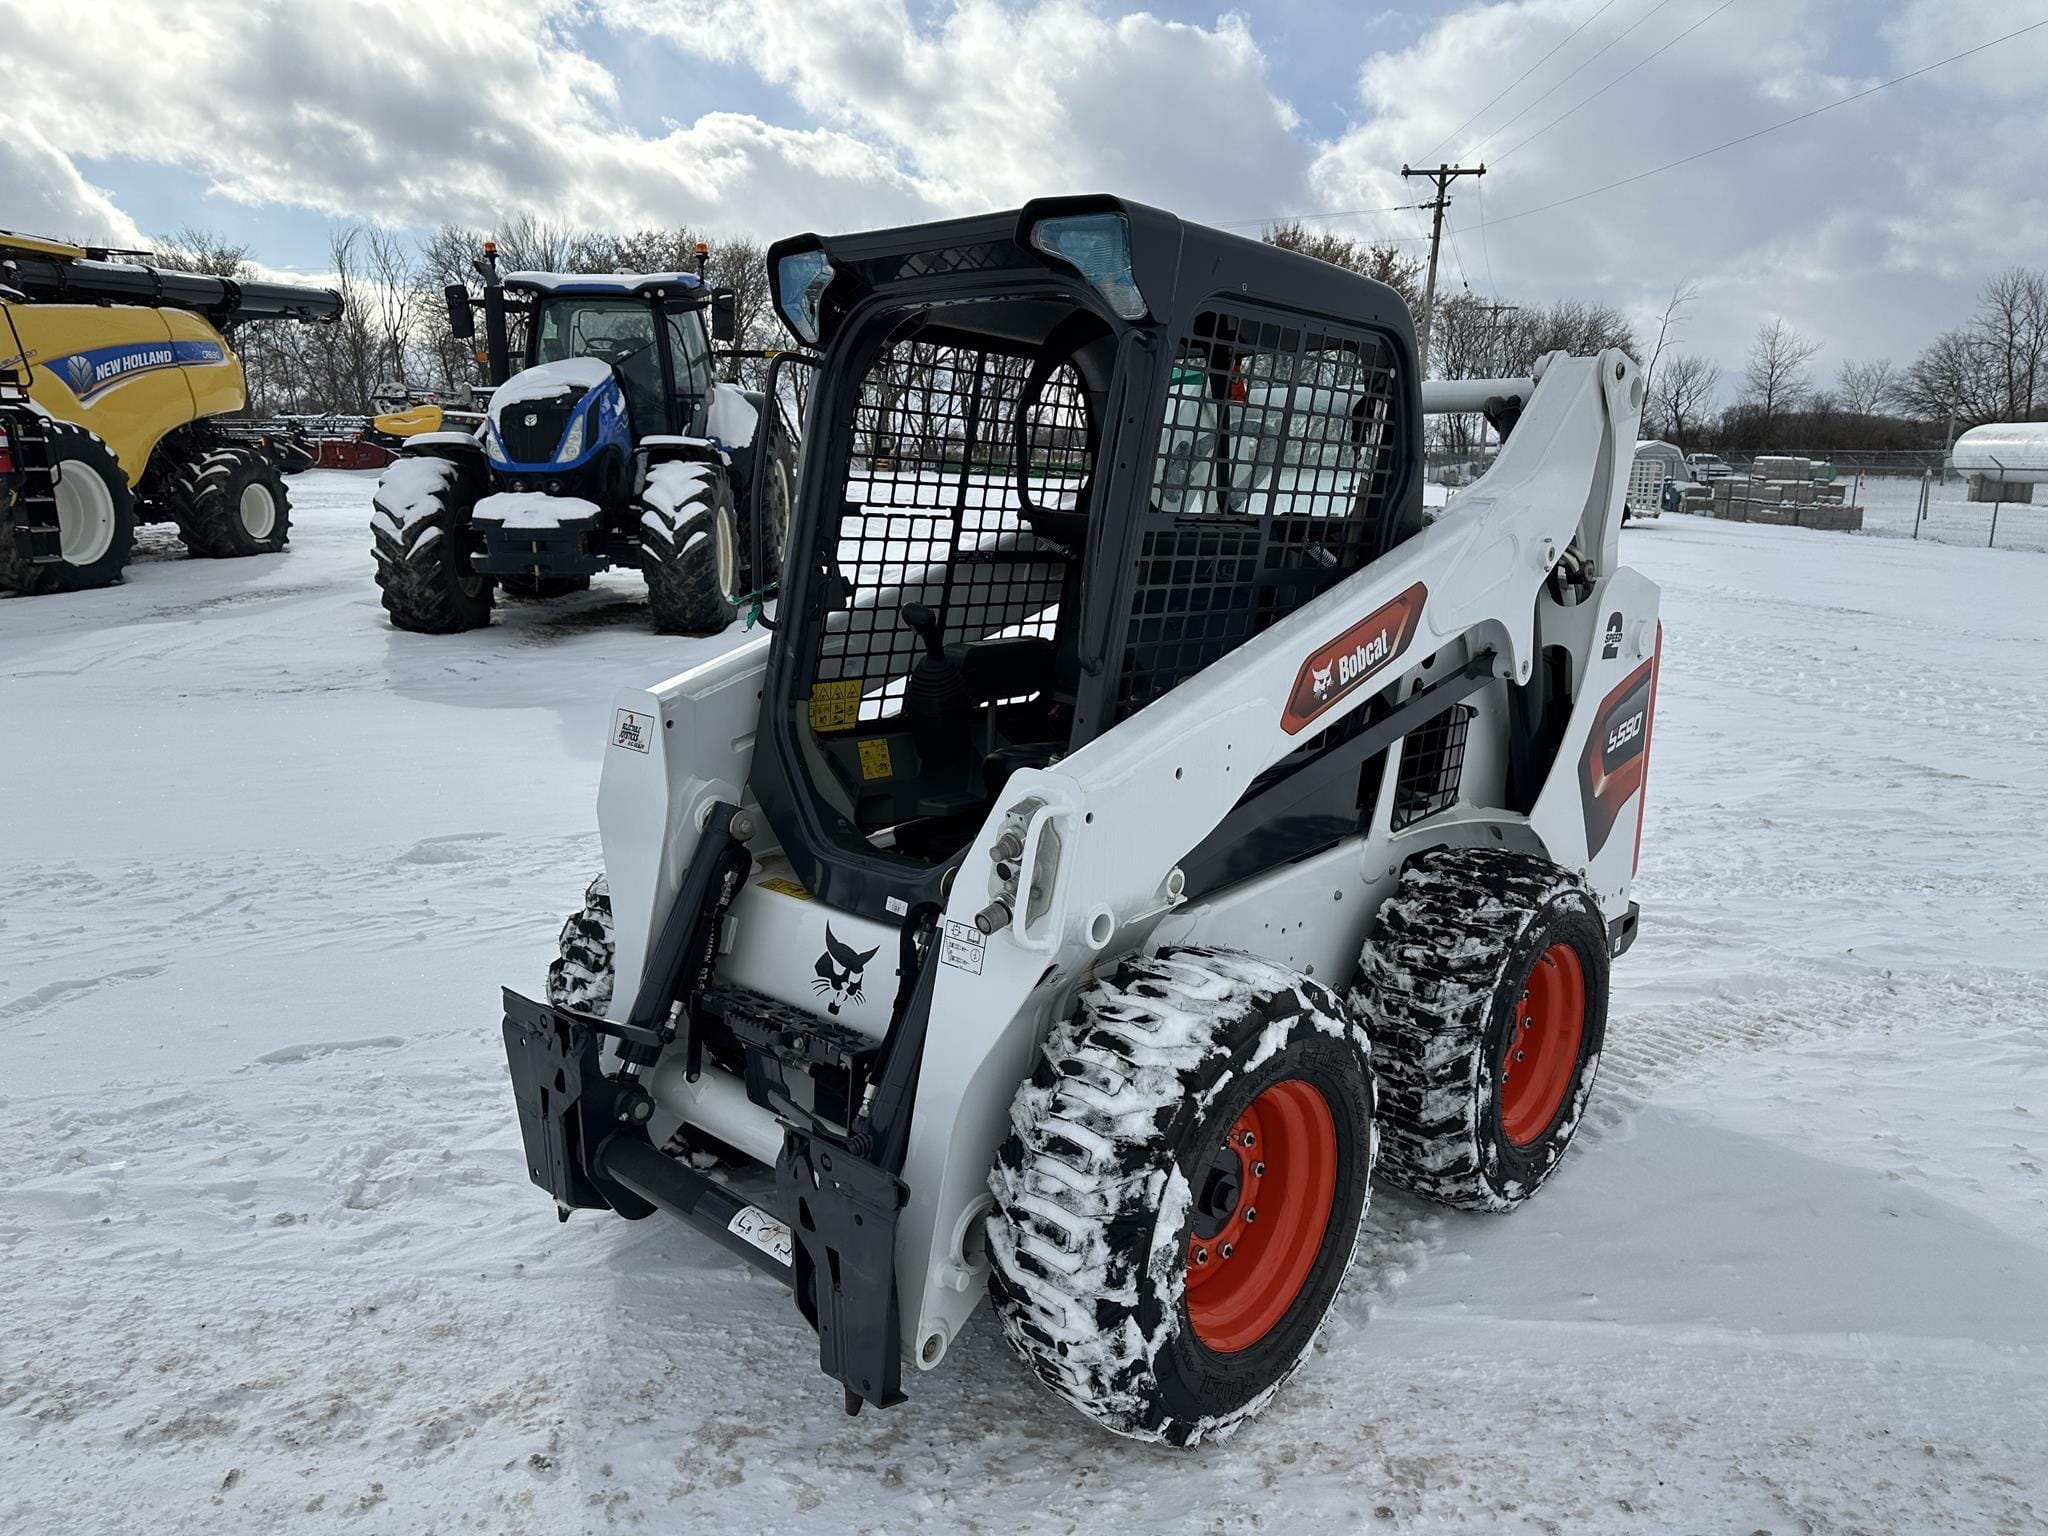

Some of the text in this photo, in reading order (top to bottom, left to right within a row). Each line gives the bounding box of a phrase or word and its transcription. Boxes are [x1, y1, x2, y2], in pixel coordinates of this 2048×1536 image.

[95, 350, 172, 380] NEW HOLLAND
[1601, 611, 1623, 659] 2
[1604, 633, 1623, 643] SPEED
[1338, 628, 1388, 686] Bobcat
[1607, 711, 1643, 754] S590
